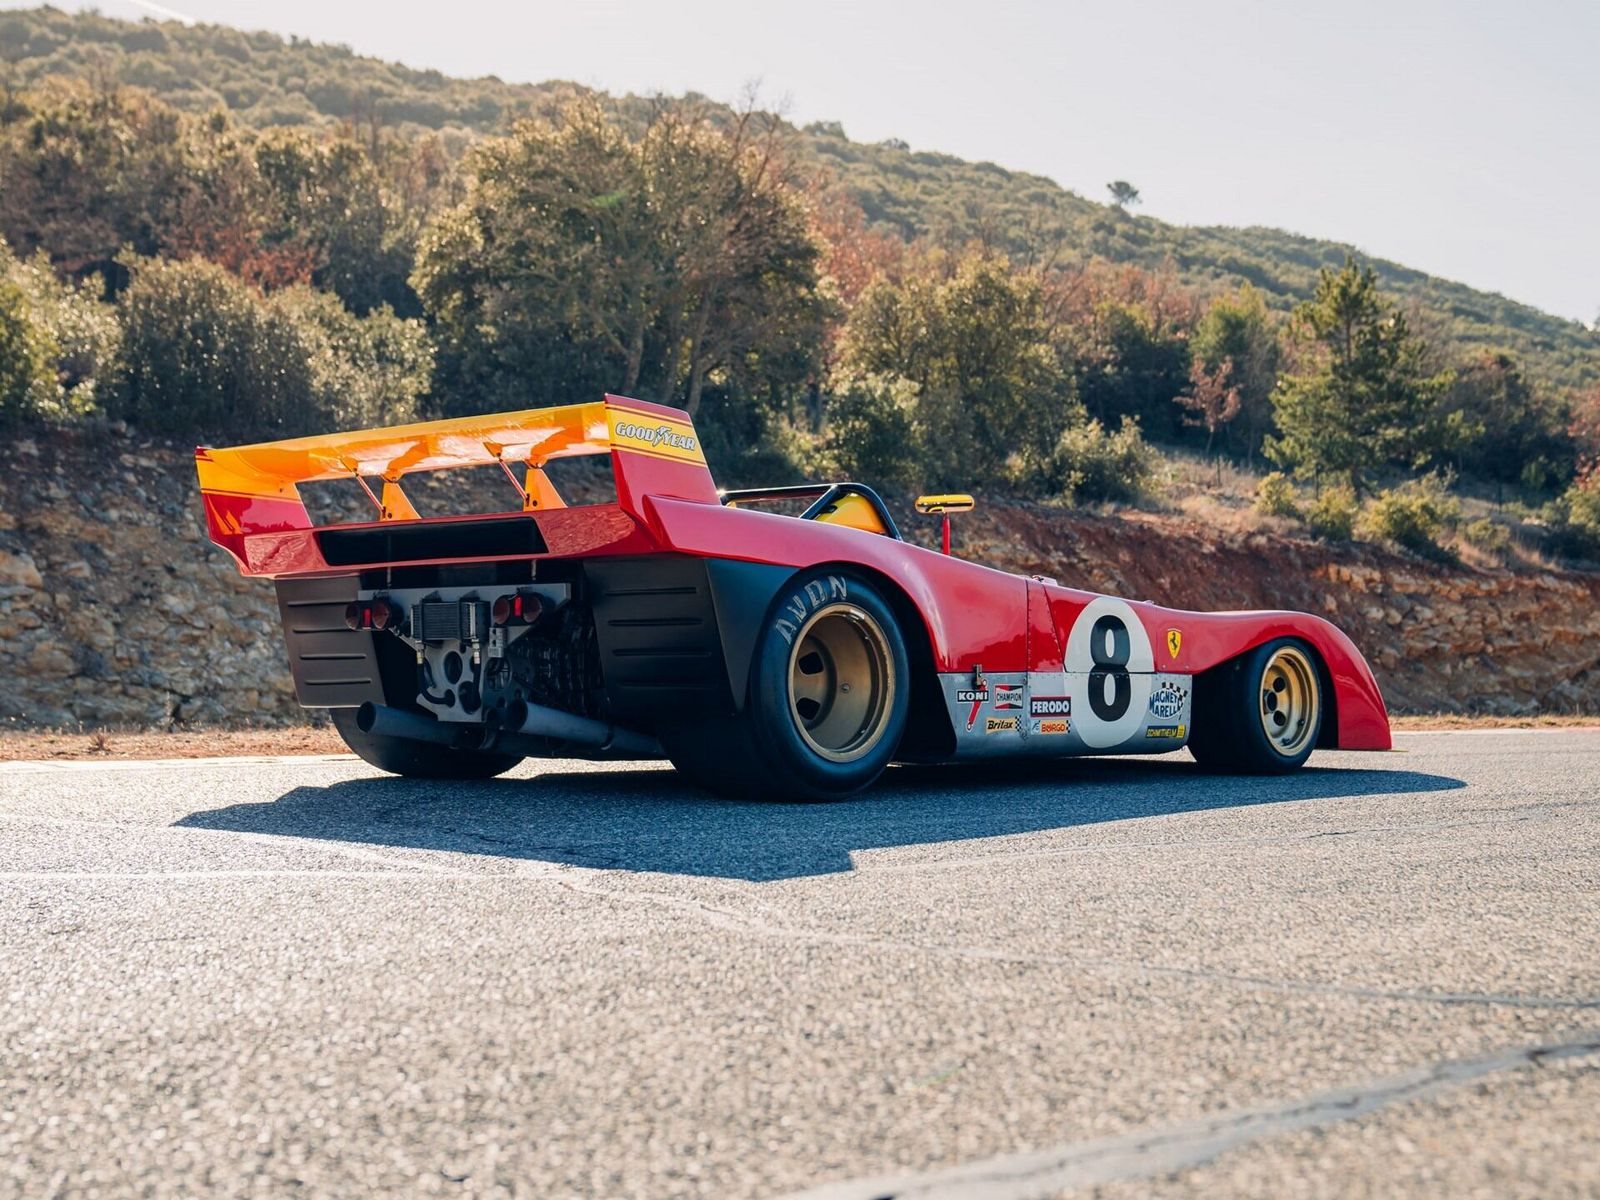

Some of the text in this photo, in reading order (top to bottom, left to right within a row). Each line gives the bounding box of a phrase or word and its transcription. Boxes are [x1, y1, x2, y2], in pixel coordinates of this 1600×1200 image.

[615, 422, 696, 451] GOODYEAR
[1089, 615, 1131, 722] 8
[958, 691, 988, 701] KONI
[996, 692, 1022, 702] CHAMPION
[1032, 700, 1070, 713] FERODO
[987, 719, 1013, 730] Britax
